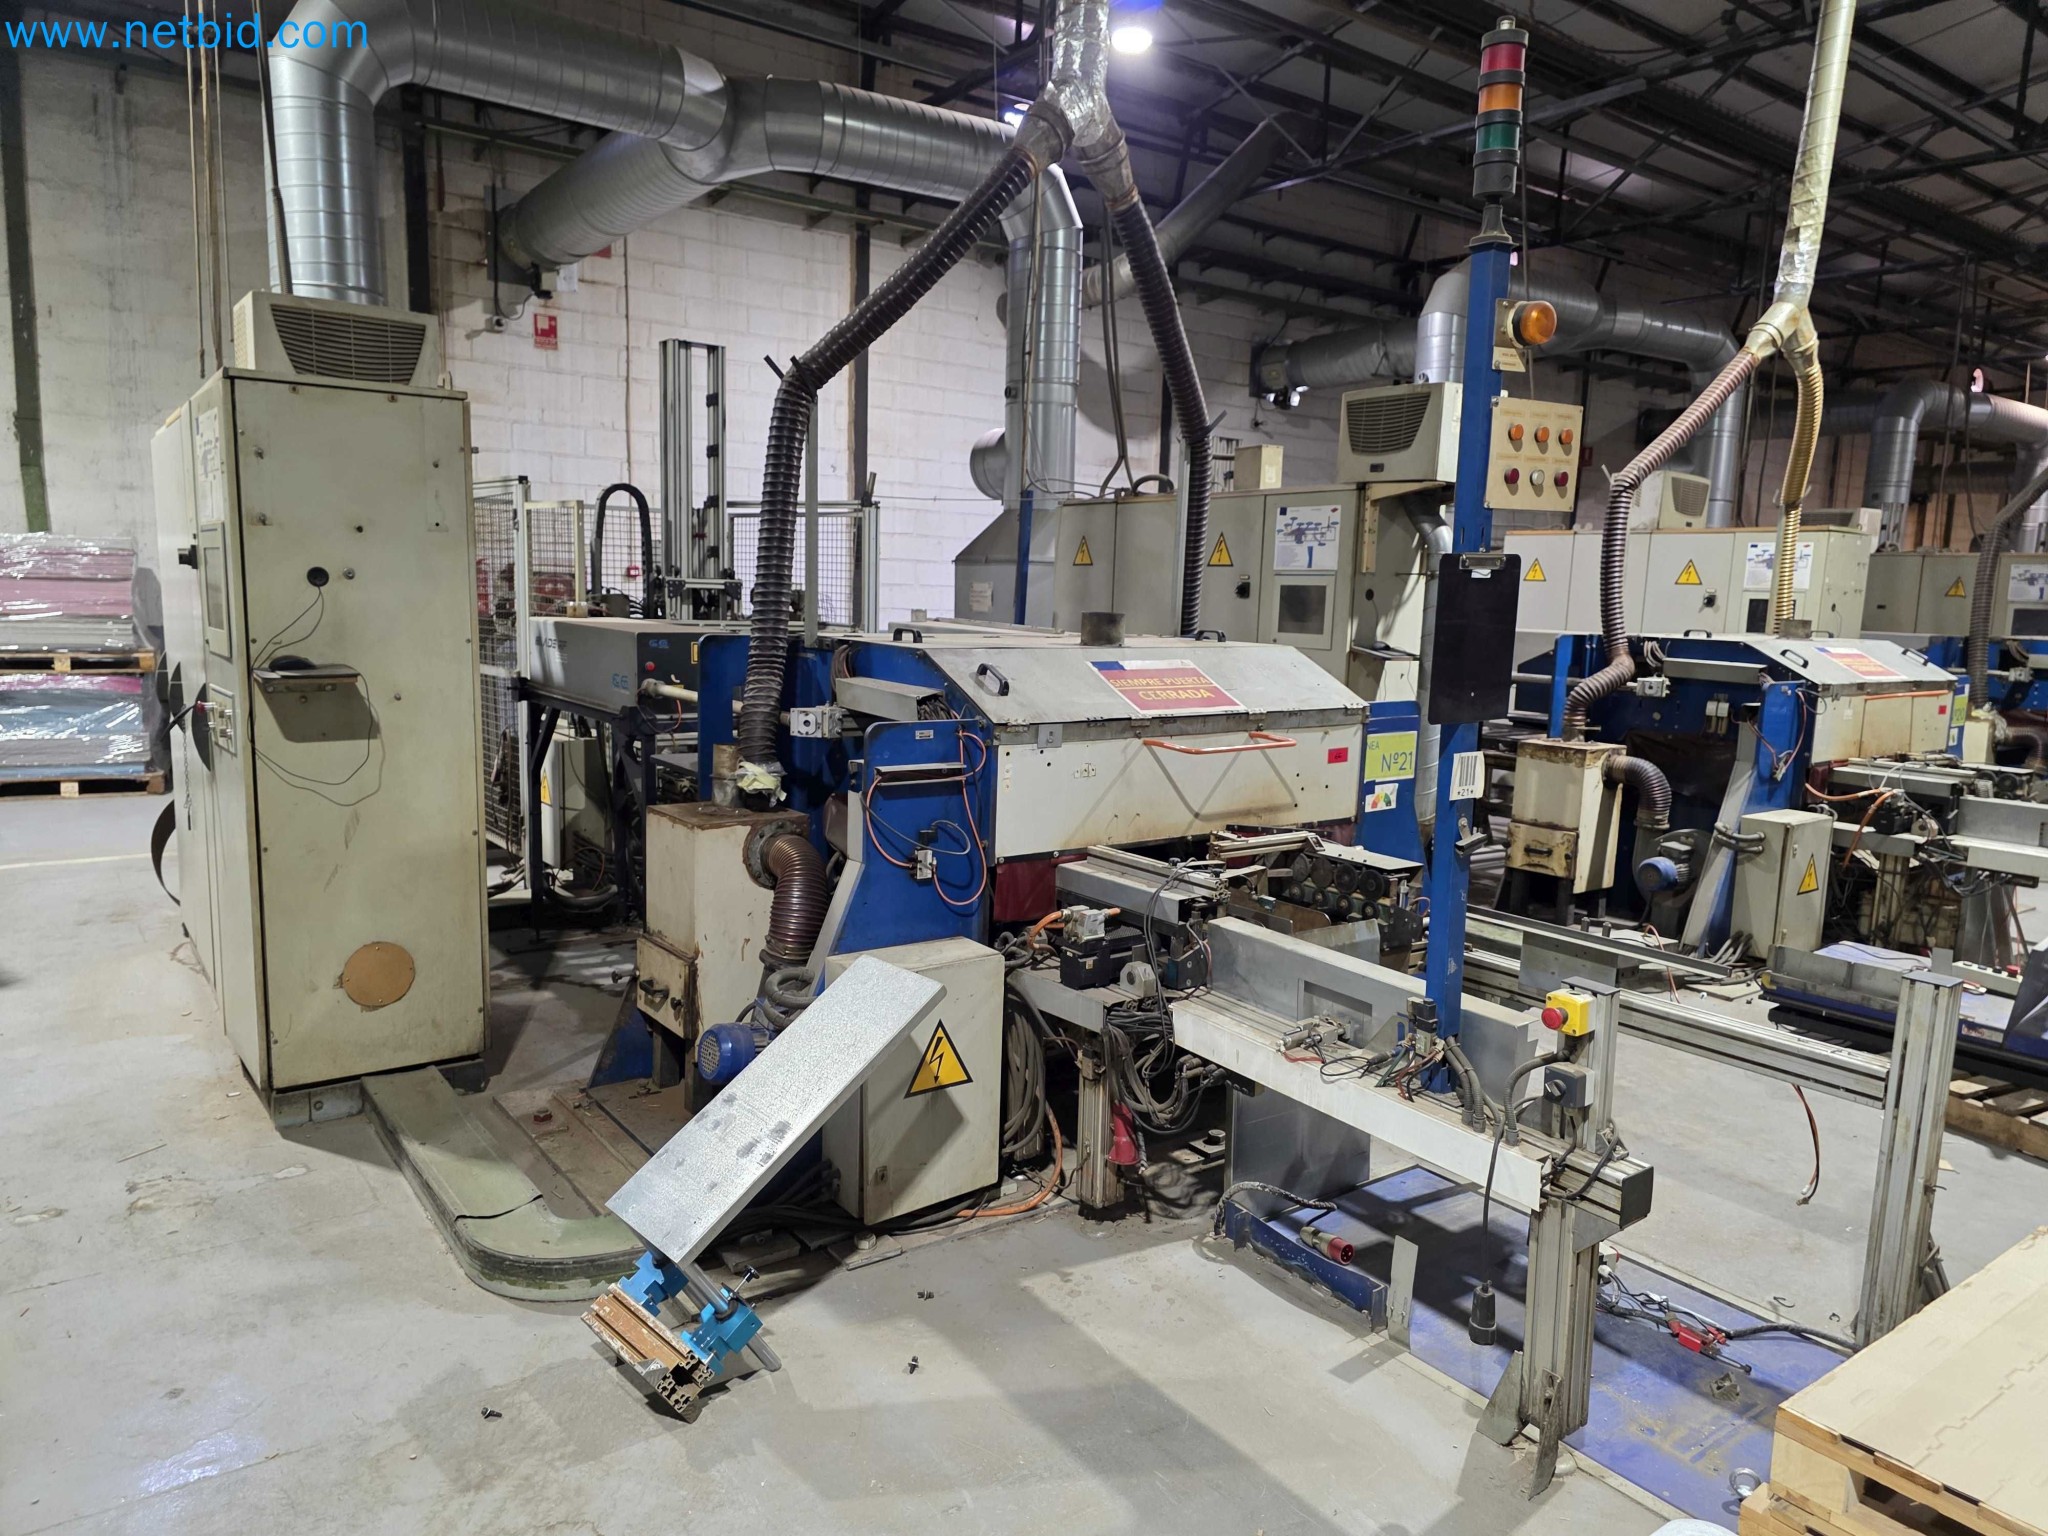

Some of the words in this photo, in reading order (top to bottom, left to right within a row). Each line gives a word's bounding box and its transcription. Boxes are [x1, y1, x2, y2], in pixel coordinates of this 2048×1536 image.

[1110, 677, 1165, 688] SIEMPRE
[1166, 676, 1211, 686] PUERTA
[1138, 688, 1215, 700] CERRADA
[1381, 751, 1413, 773] Nº21
